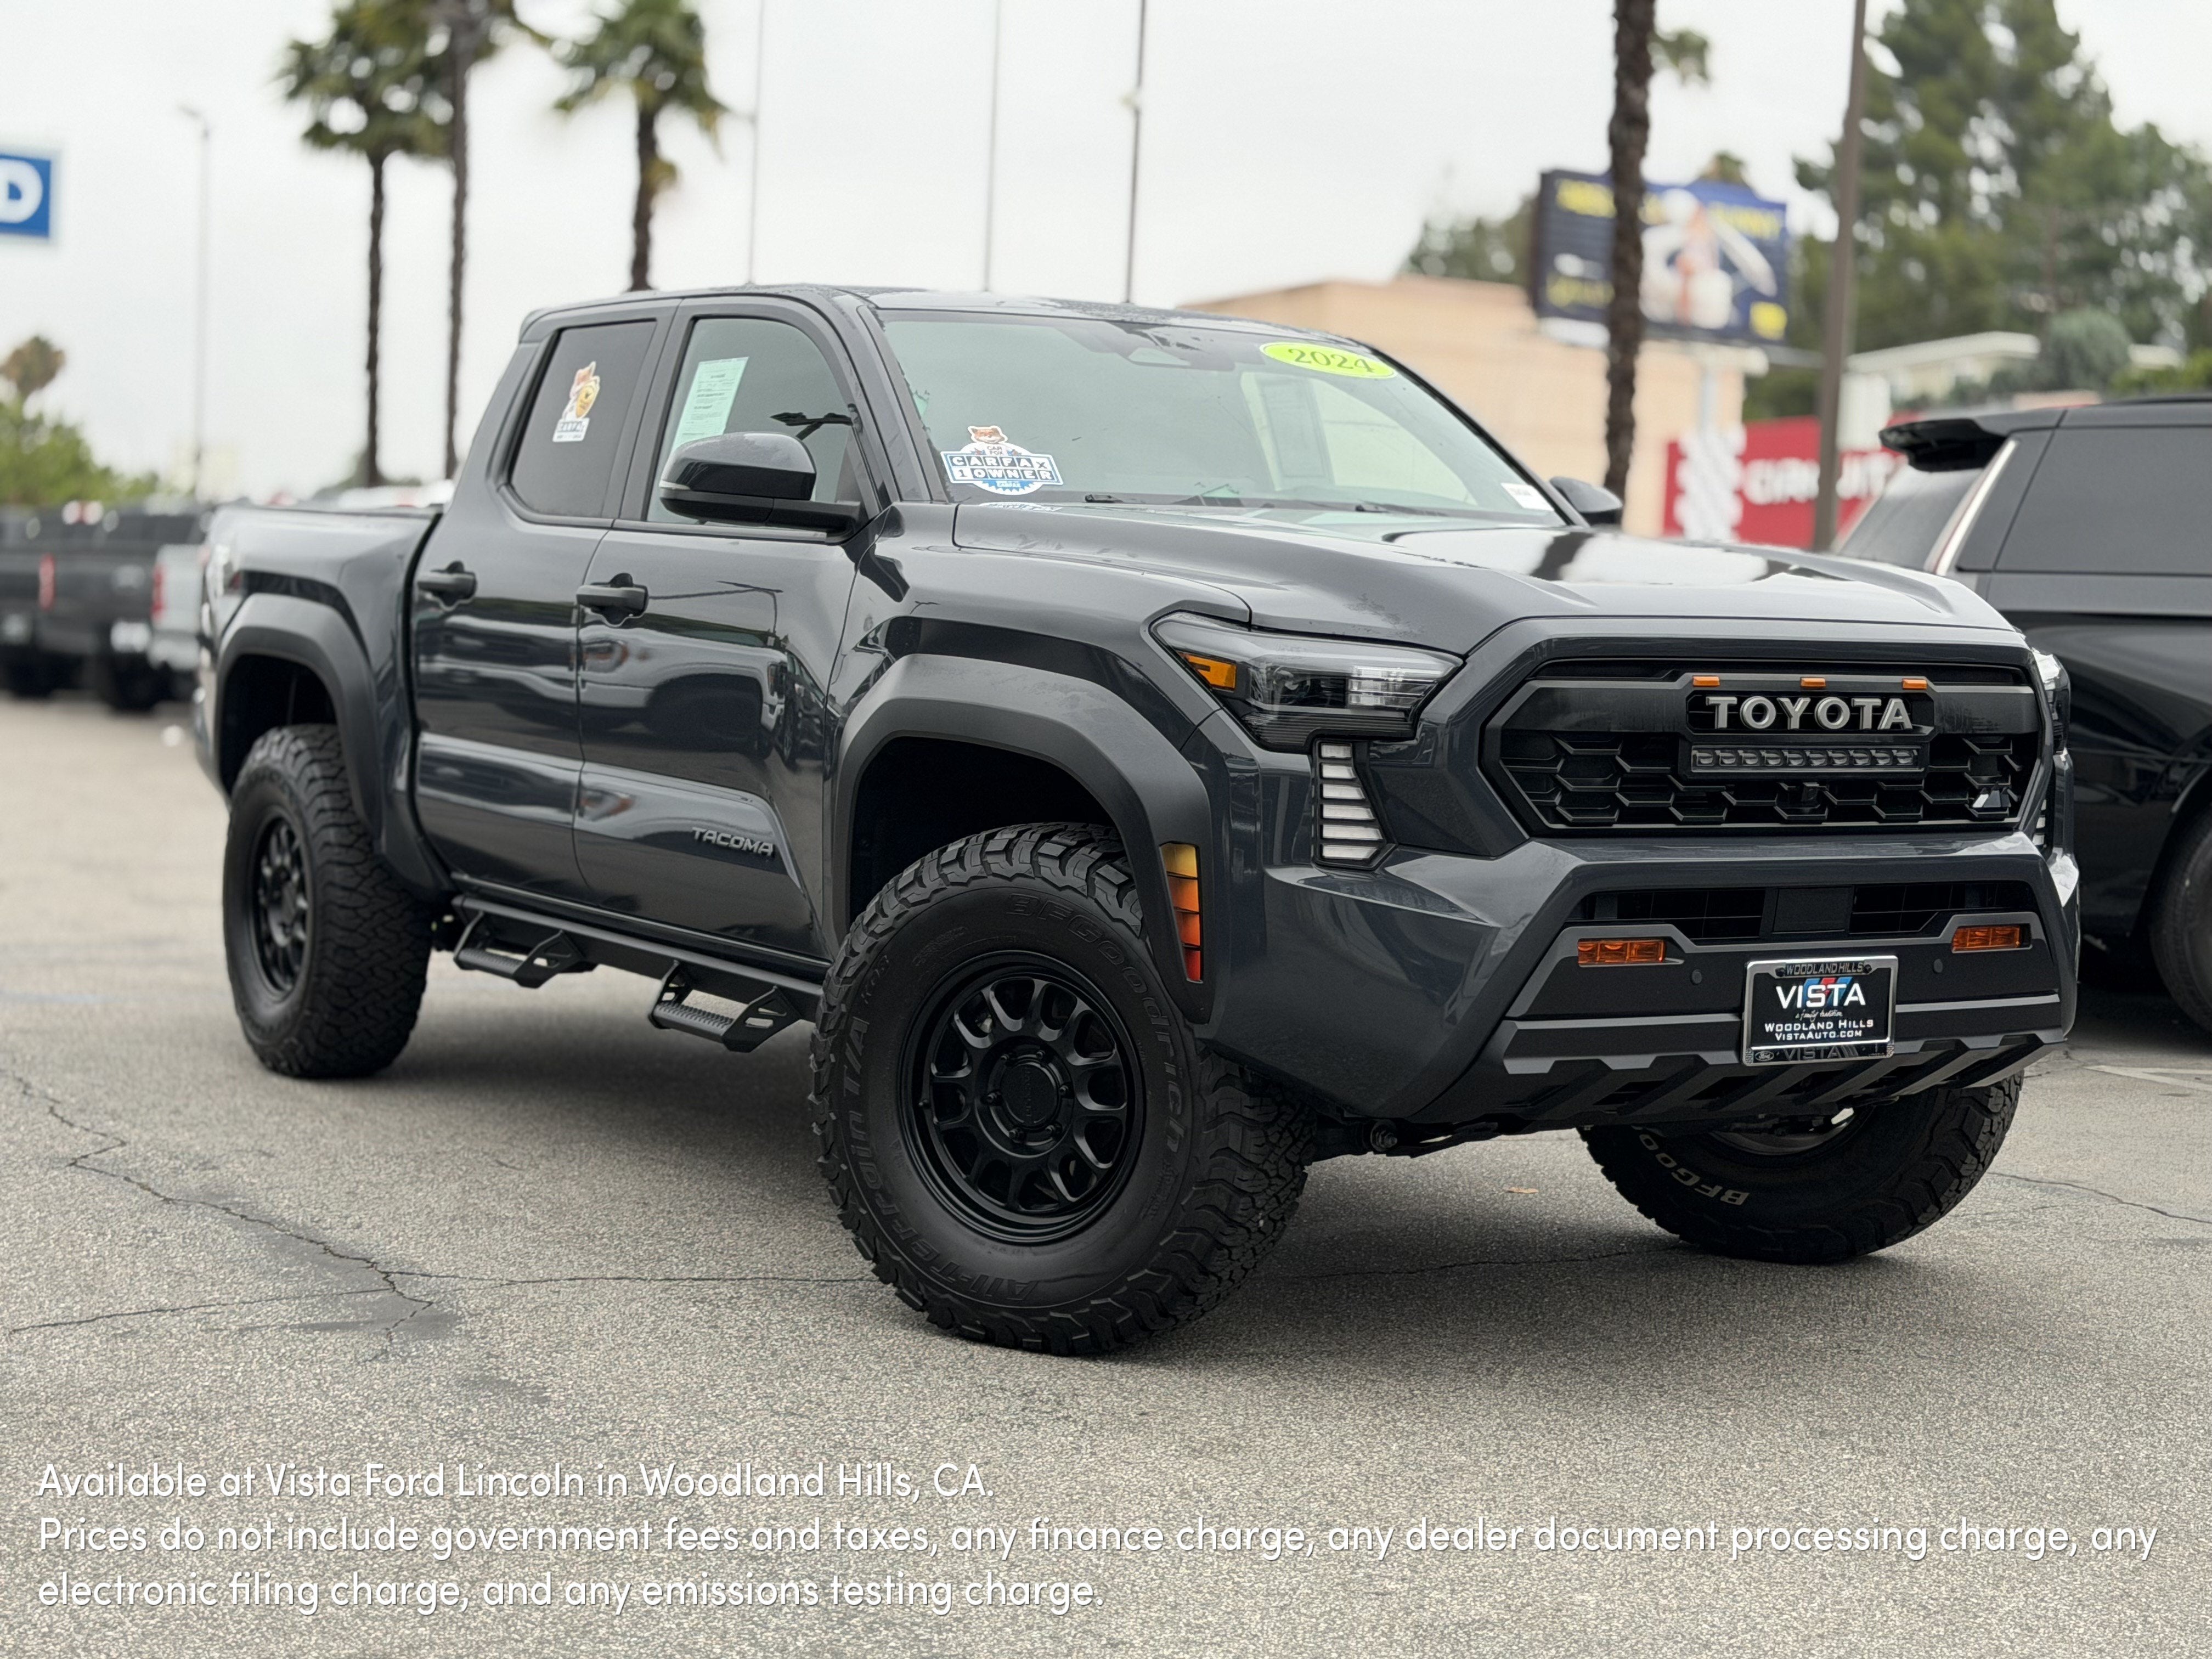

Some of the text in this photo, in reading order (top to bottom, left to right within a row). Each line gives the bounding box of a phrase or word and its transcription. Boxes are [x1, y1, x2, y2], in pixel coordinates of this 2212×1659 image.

[1288, 347, 1375, 374] 2024
[950, 456, 1048, 469] CARFAX
[957, 469, 1053, 481] 1 OWNER
[1705, 696, 1913, 730] TOYOTA
[691, 827, 774, 857] TACOMA
[1786, 962, 1864, 975] WOODLAND HILLS
[1775, 983, 1866, 1009] VISTA
[1764, 1019, 1874, 1032] WOODLAND HILLS
[1783, 1045, 1842, 1062] VISTA
[1639, 1127, 1751, 1206] BFGOO
